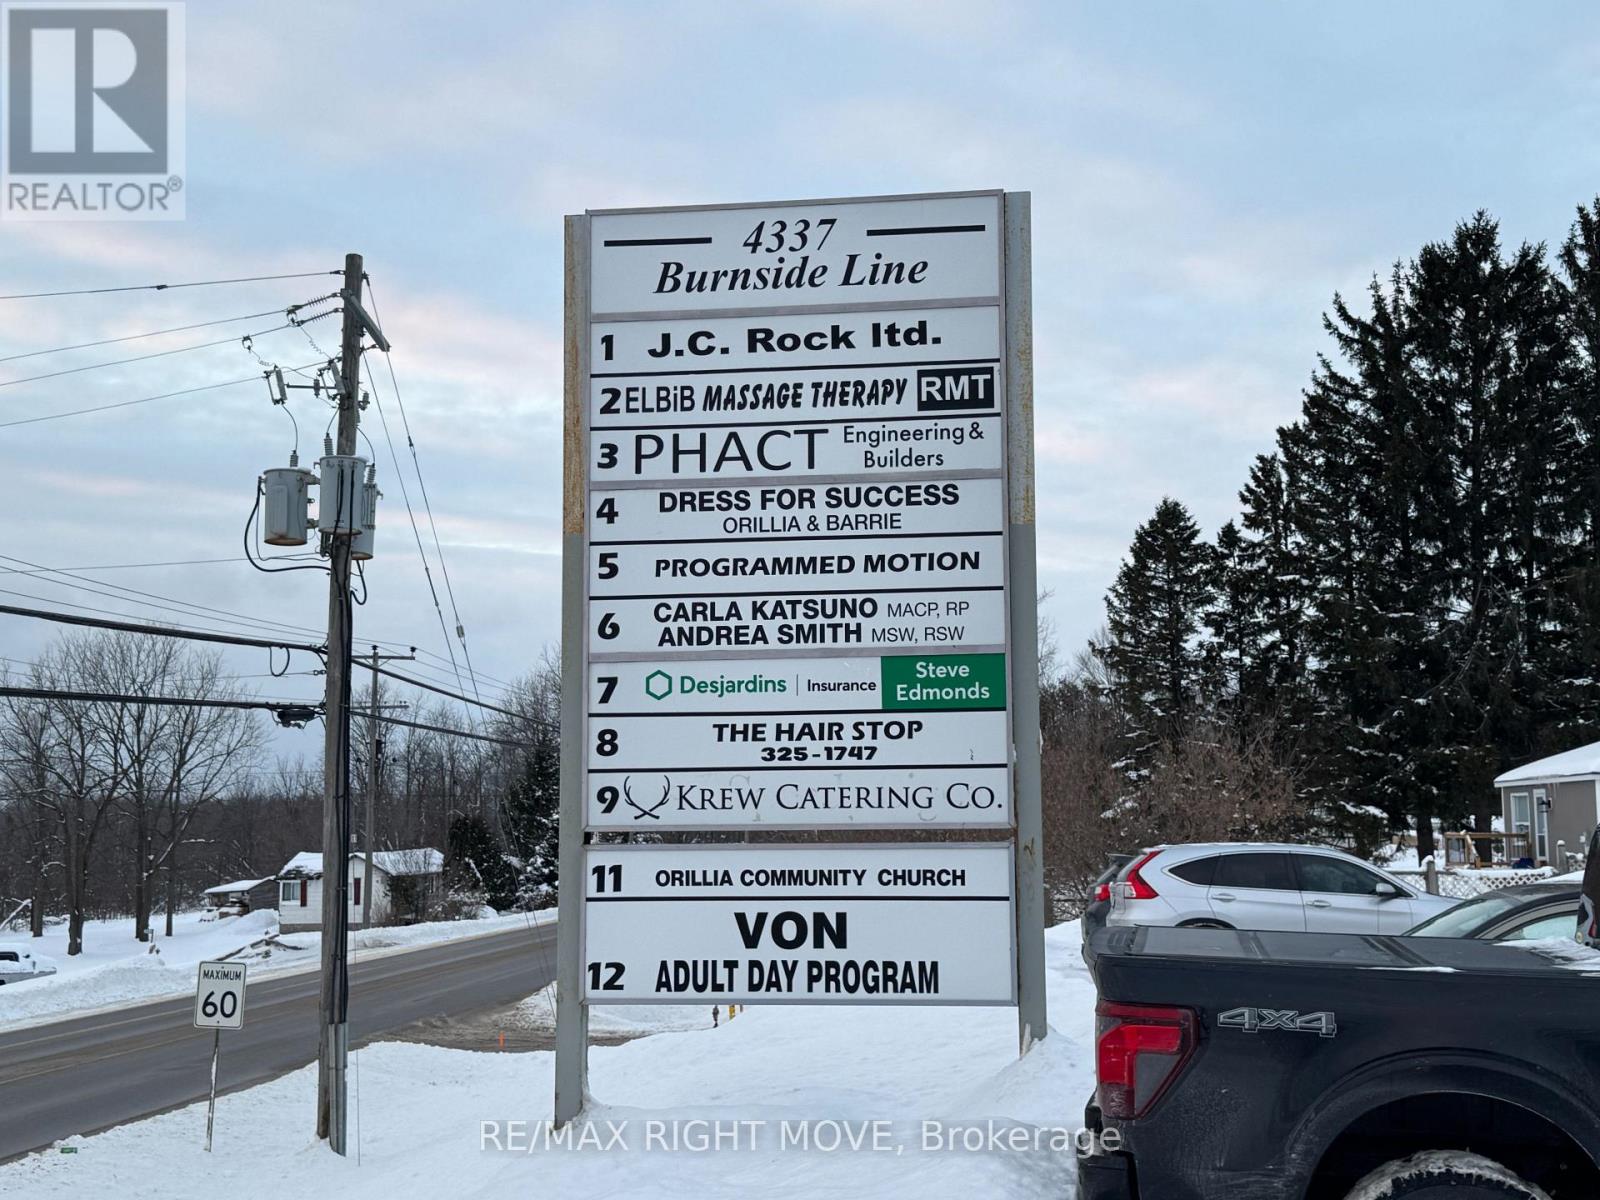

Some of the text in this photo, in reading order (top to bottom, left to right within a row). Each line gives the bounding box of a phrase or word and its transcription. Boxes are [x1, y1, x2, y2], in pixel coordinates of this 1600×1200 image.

[743, 219, 837, 254] 4337
[653, 253, 928, 293] Burnside Line
[601, 320, 941, 360] 1 J.C. Rock ltd.
[600, 374, 991, 414] 2 ELBiB MASSAGE THERAPY RMT
[844, 422, 984, 448] Engineering &
[597, 429, 829, 474] 3 PHACT
[865, 447, 943, 468] Builders
[596, 484, 959, 524] 4 DRESS FOR SUCCESS
[723, 513, 901, 533] ORILLIA & BARRIE
[598, 552, 979, 579] 5 PROGRAMMED MOTION
[654, 598, 969, 623] CARLA KATSUNO MACP, RP
[598, 613, 620, 639] 6
[658, 623, 964, 646] ANDREA SMITH MSW, RSW
[916, 661, 970, 678] Steve
[597, 675, 876, 704] 7 Desjardins Insurance
[896, 682, 990, 700] Edmonds
[596, 729, 618, 756] 8
[713, 721, 923, 742] THE HAIR STOP
[761, 746, 877, 761] 325-1747
[597, 786, 619, 813] 9
[677, 785, 765, 810] KREW
[776, 784, 933, 809] CATERING
[592, 865, 965, 893] 11 ORILLIA COMMUNITY CHURCH
[734, 911, 847, 949] VON
[203, 969, 242, 981] MAXIMUM
[588, 960, 939, 994] 12 ADULT DAY PROGRAM
[202, 990, 237, 1018] 60
